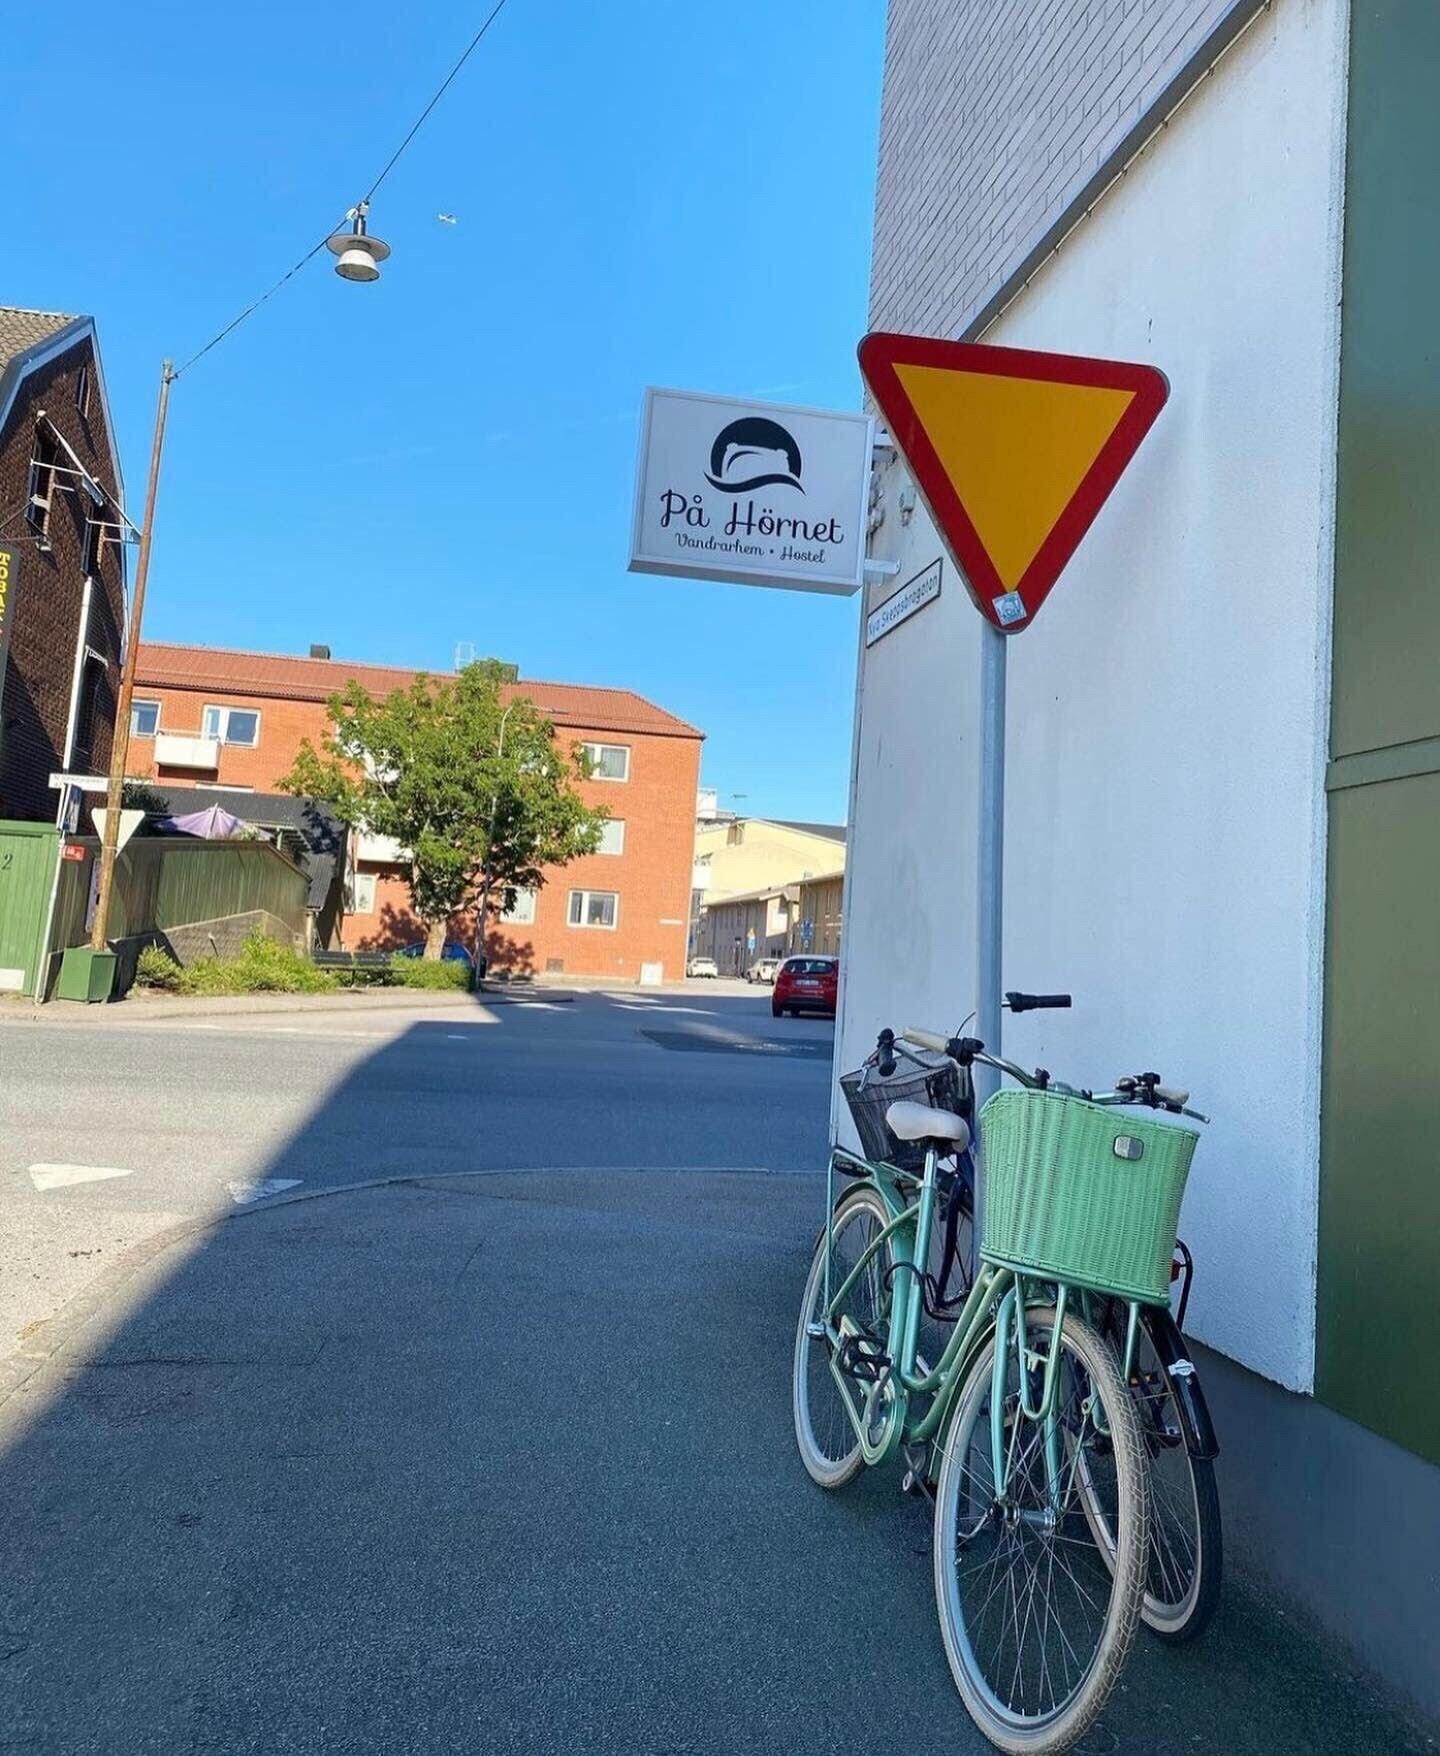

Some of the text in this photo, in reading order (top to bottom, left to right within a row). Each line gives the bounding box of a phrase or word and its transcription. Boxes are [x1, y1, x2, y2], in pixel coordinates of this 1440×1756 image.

[660, 489, 844, 544] På Hörnet
[675, 532, 825, 564] Vandrarhem Hostel
